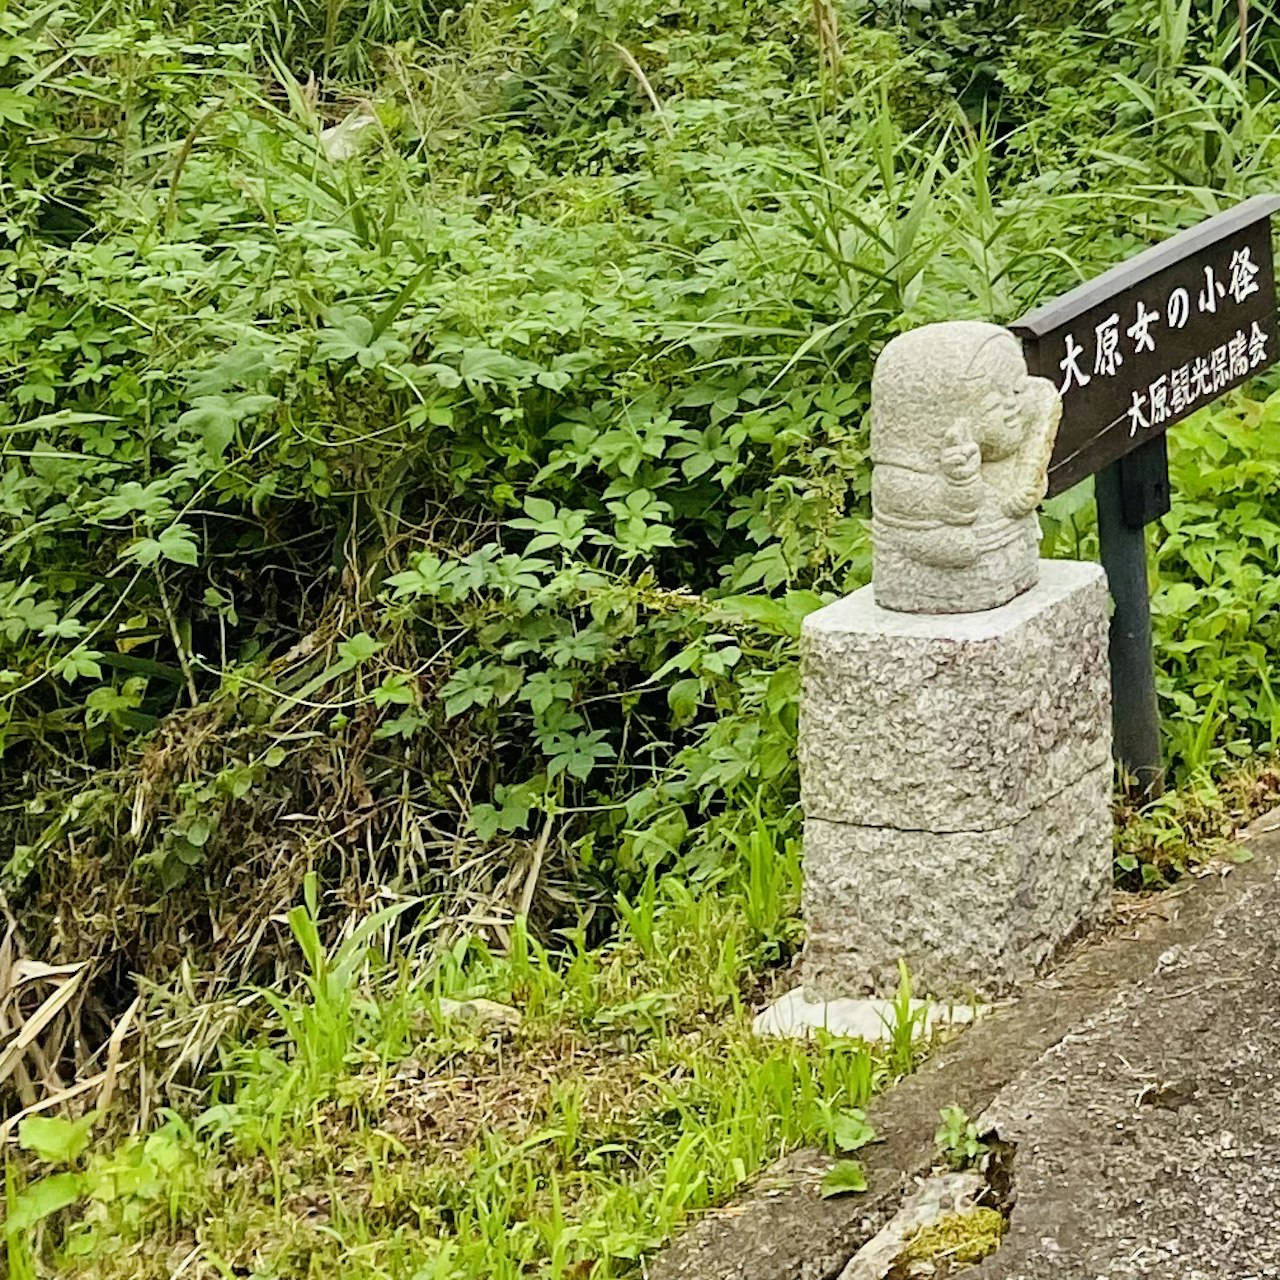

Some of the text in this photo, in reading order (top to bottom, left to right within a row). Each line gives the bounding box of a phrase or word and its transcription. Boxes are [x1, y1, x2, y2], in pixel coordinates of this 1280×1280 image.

[1058, 246, 1260, 395] 大原女の小径
